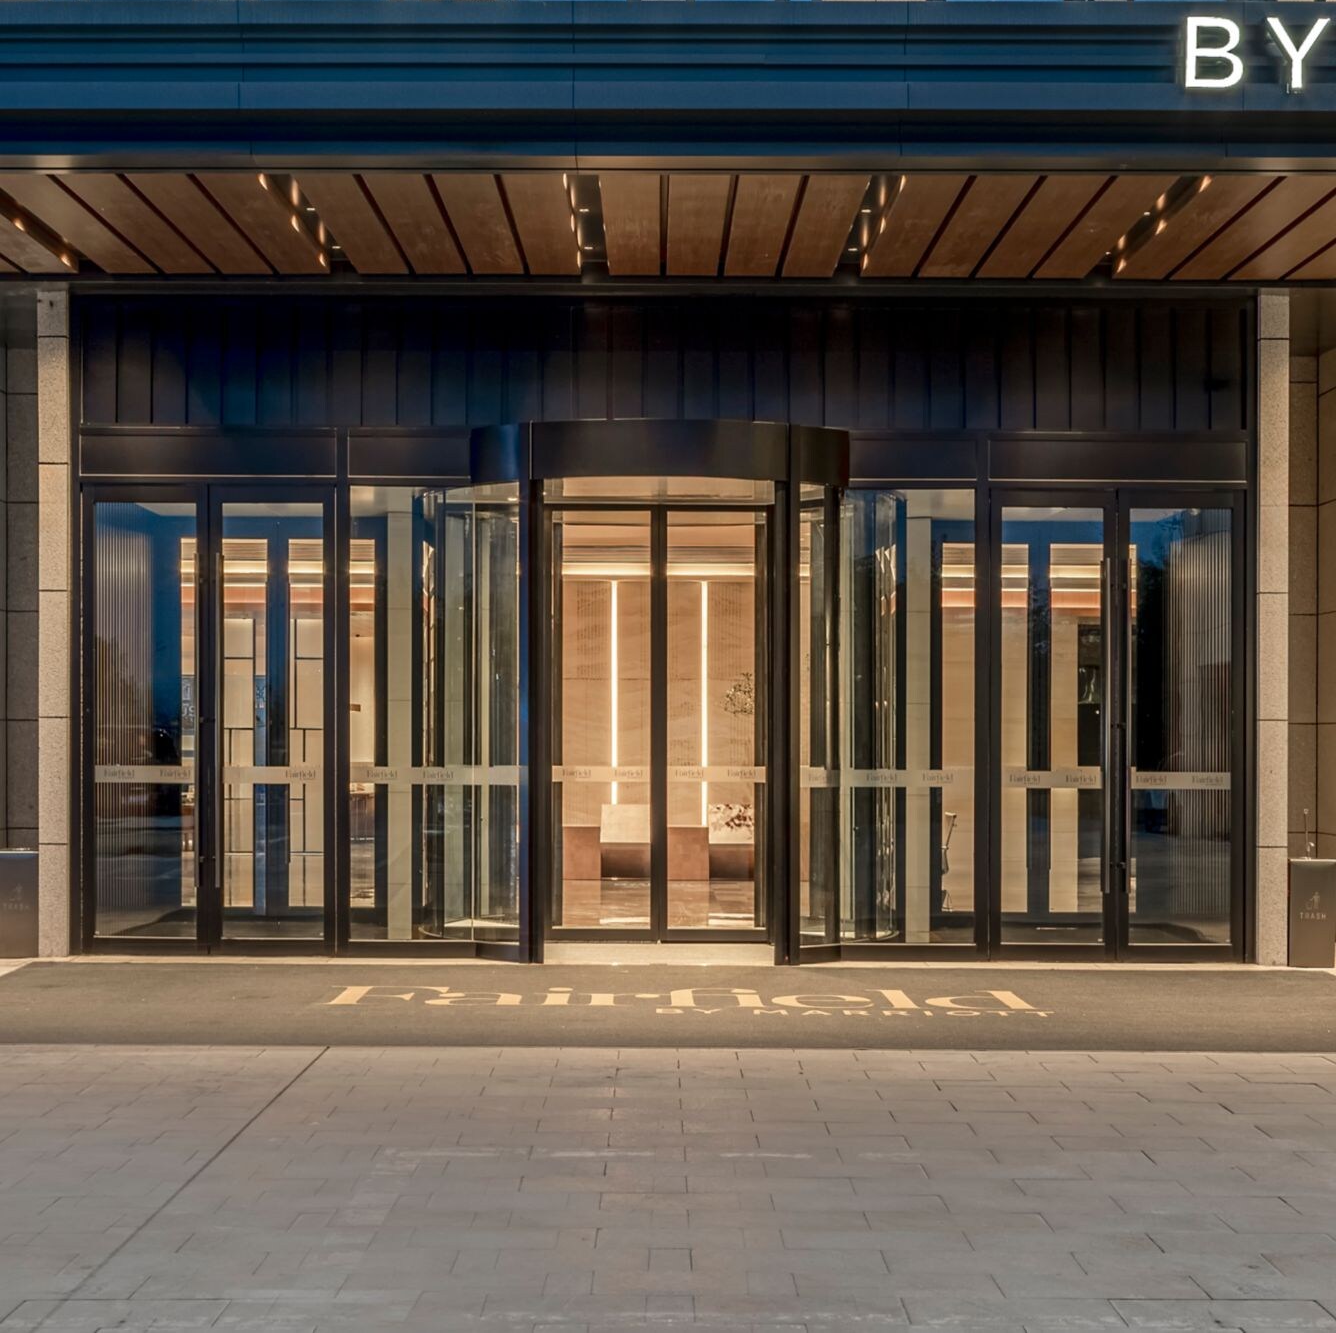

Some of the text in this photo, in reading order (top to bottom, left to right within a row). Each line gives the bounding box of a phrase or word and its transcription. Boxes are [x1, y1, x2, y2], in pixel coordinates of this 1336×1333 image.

[1183, 16, 1331, 90] BY
[316, 985, 1038, 1009] Fairfield
[752, 1009, 1057, 1017] MARRIOTT
